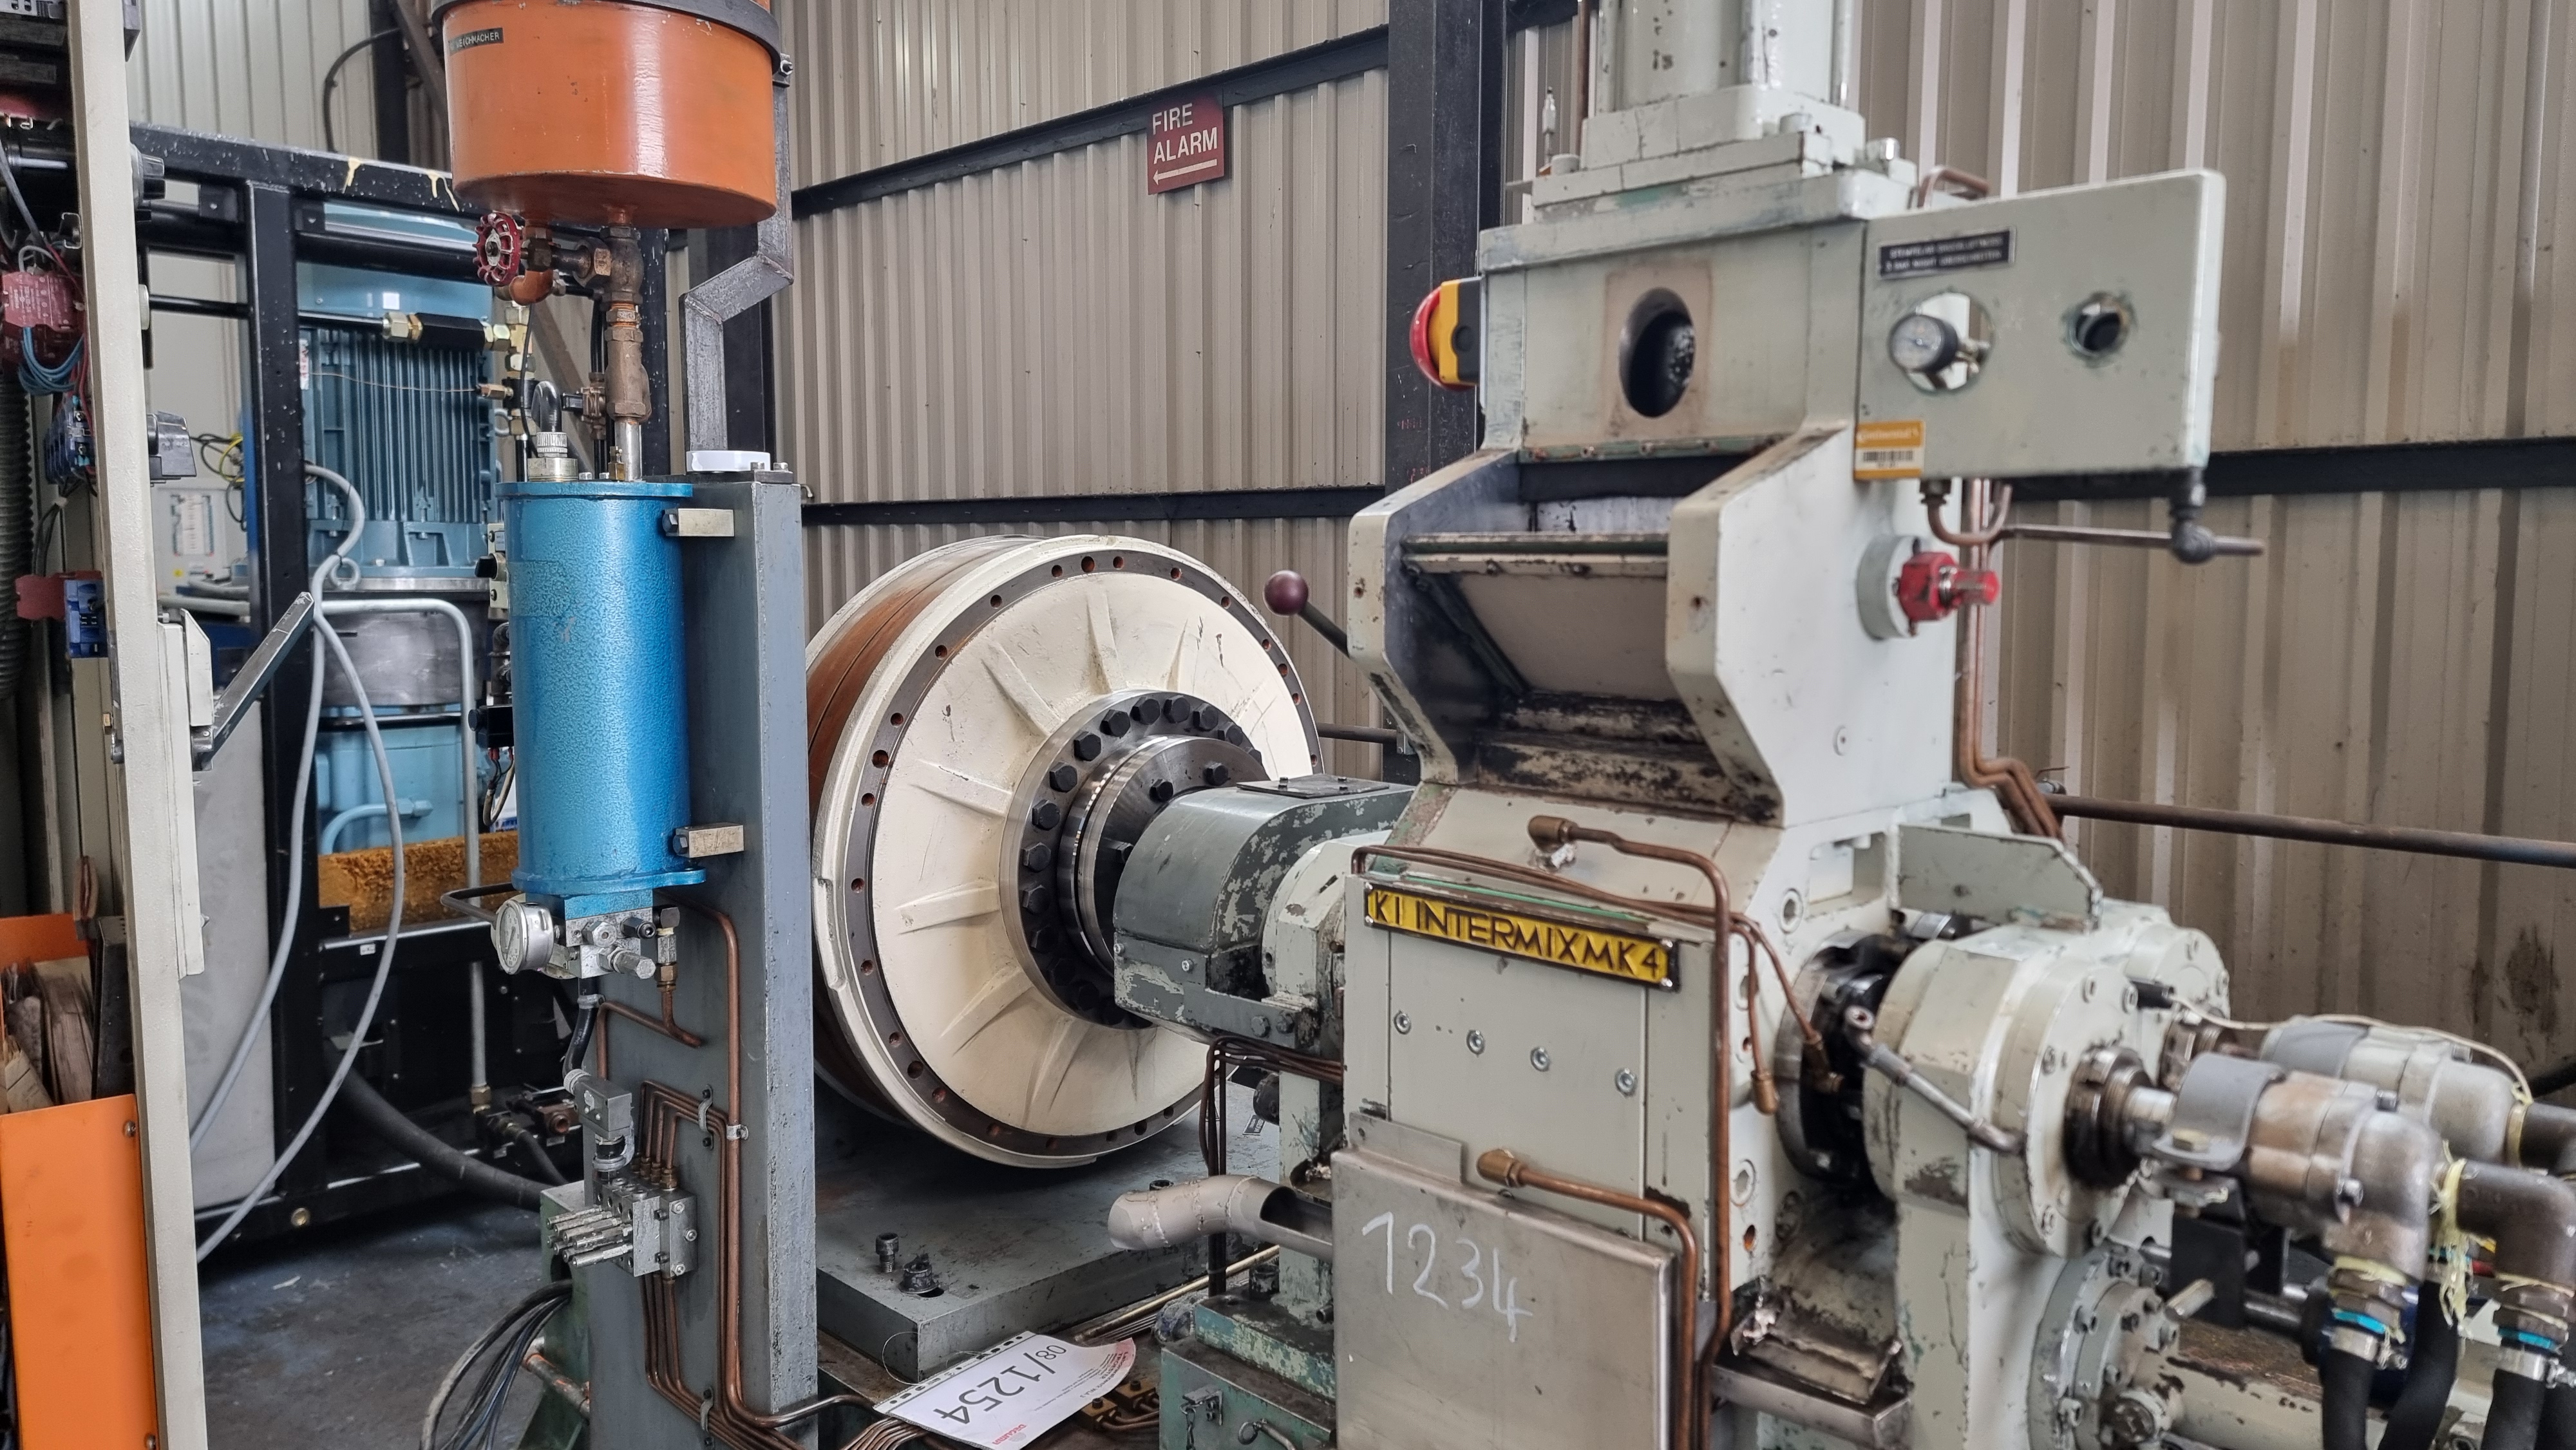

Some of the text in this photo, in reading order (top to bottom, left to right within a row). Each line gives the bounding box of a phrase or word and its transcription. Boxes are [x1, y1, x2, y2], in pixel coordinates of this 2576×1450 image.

[1153, 103, 1193, 135] FIRE
[1153, 127, 1217, 164] ALARM
[1362, 1212, 1533, 1342] 1234
[933, 1345, 1066, 1424] 08/1254
